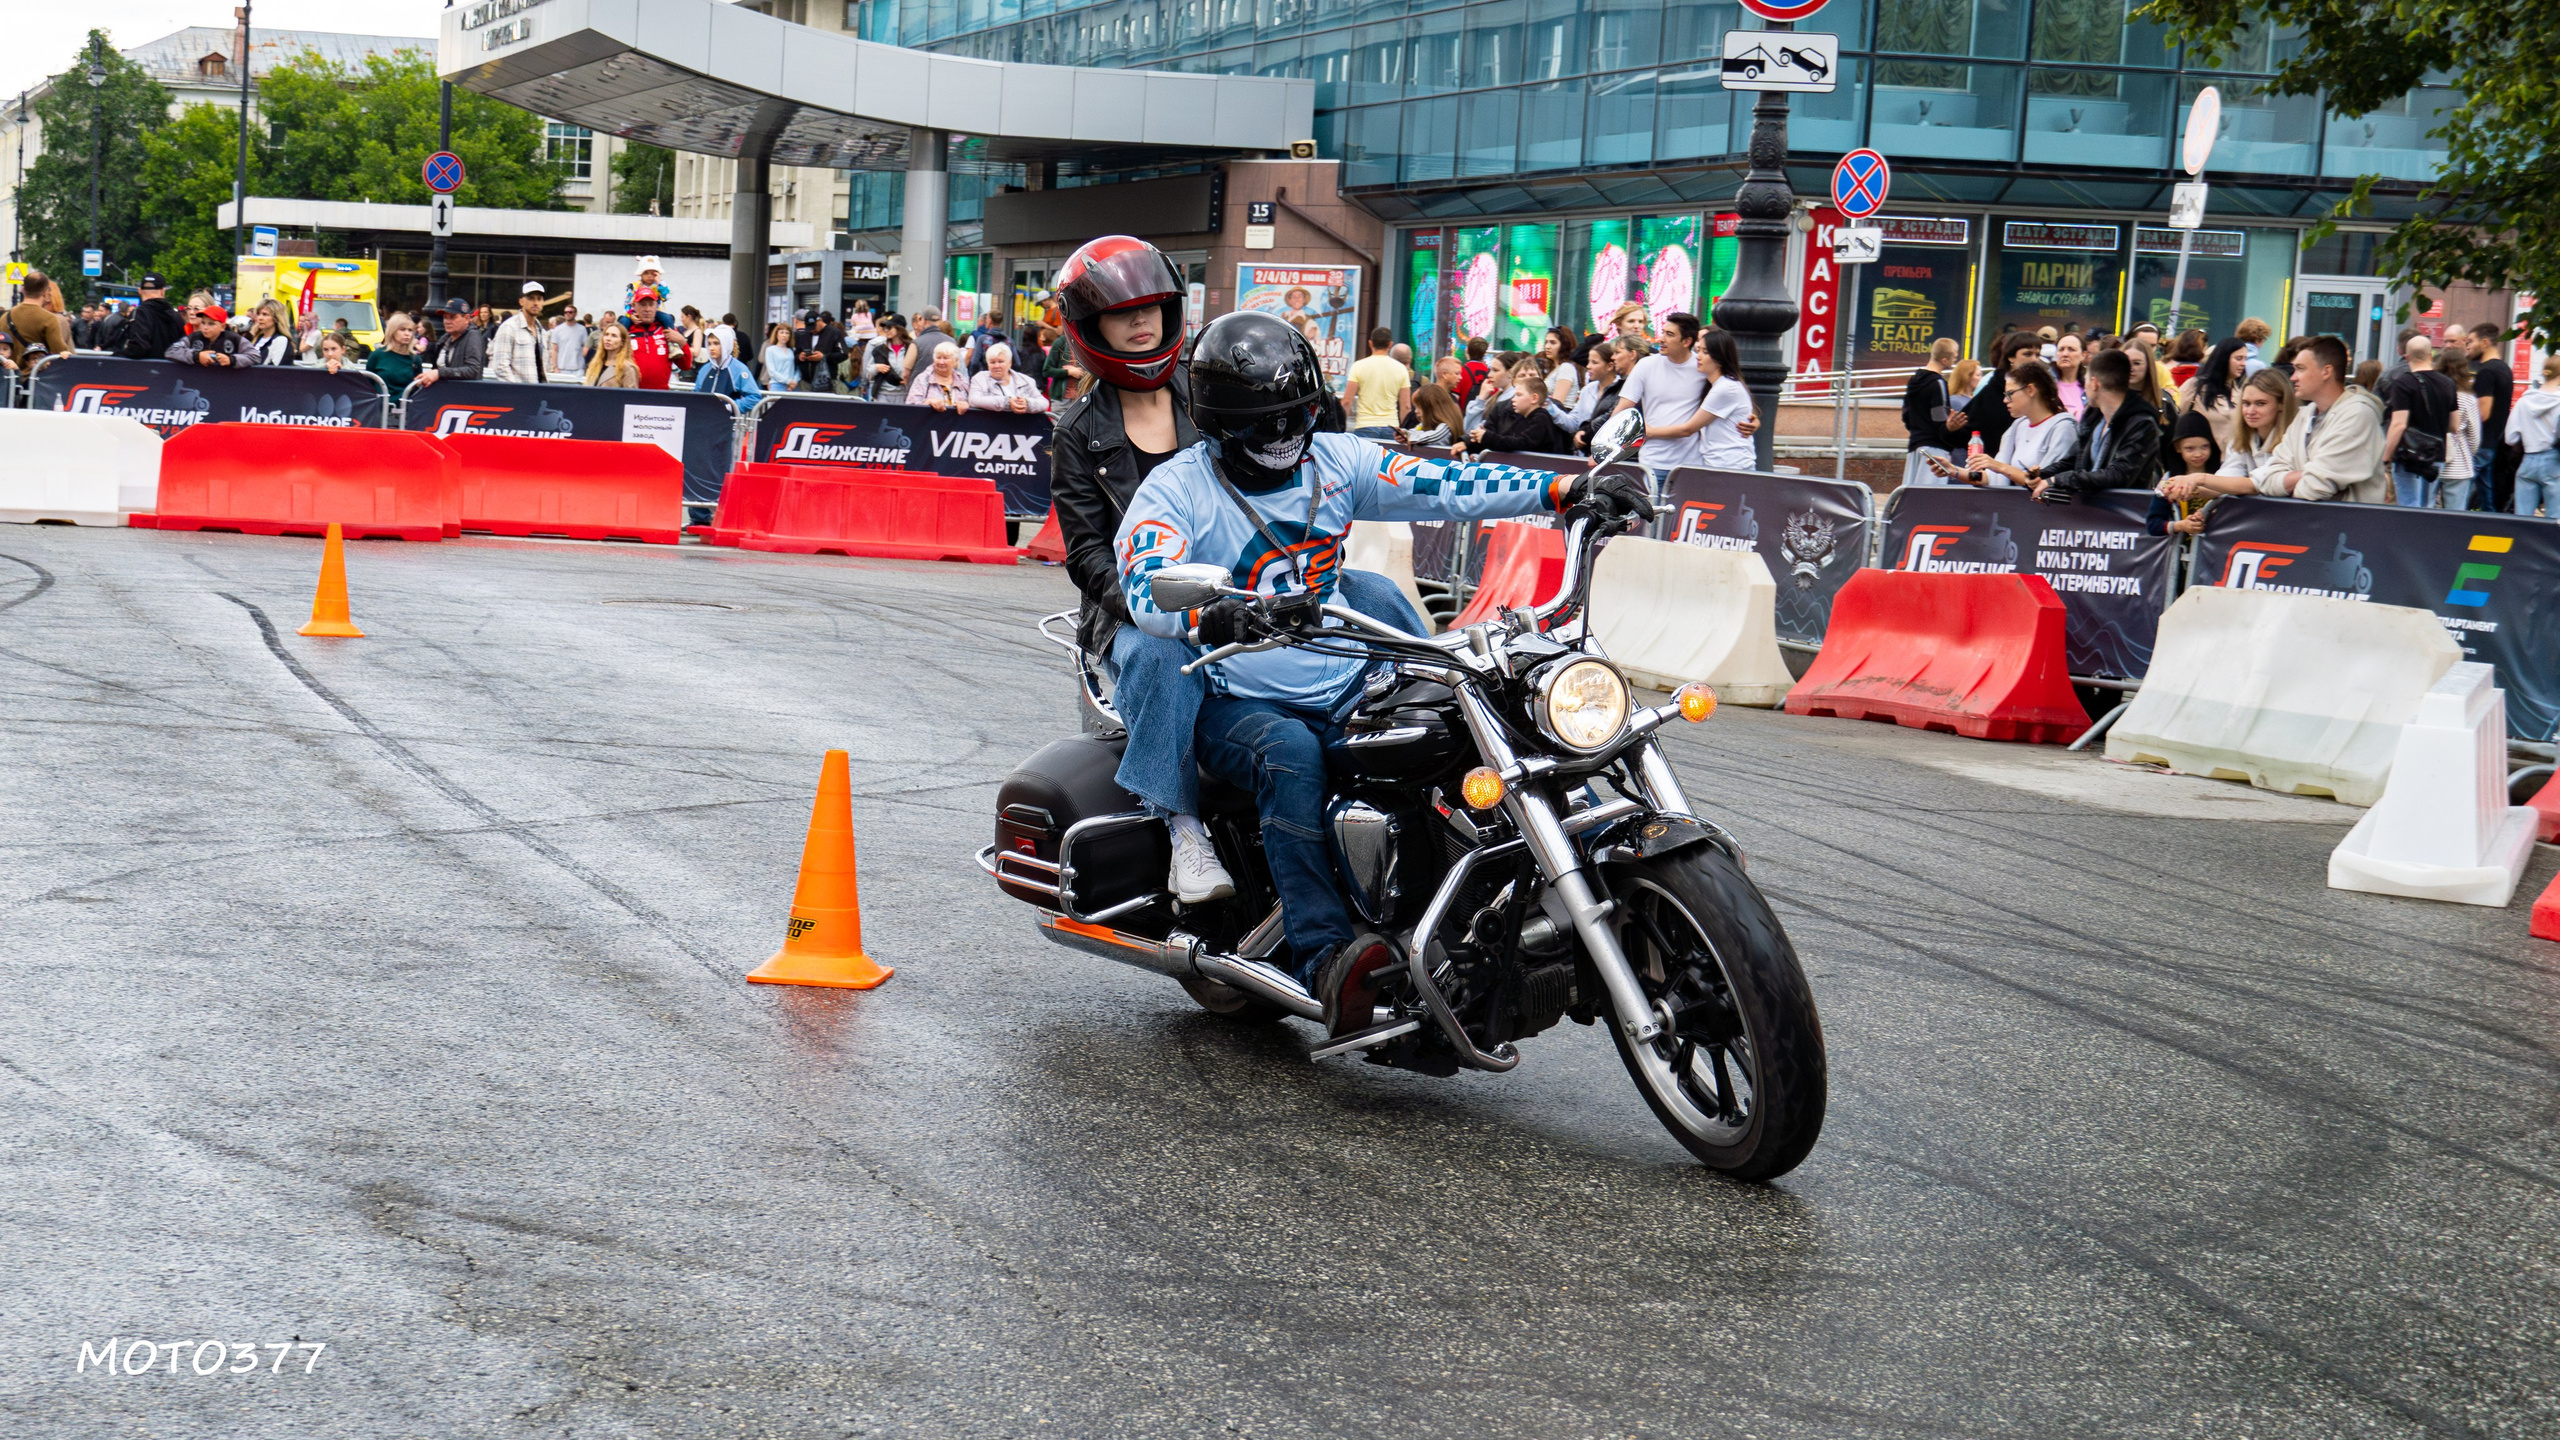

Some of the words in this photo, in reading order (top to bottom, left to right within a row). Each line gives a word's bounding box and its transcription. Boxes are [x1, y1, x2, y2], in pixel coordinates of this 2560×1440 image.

[1252, 204, 1270, 217] 15
[1901, 221, 1964, 235] ЭСТРАДЫ
[2008, 226, 2049, 239] ТЕАТР
[853, 266, 889, 280] ТАБА
[1255, 270, 1300, 284] 2/4/8/9
[2022, 262, 2094, 288] ПАРНИ
[1803, 224, 1835, 380] КАССА
[2310, 294, 2354, 309] КАССА
[1871, 323, 1934, 341] ТЕАТР
[775, 427, 911, 464] ДВИЖЕНИЕ
[930, 430, 1044, 462] VIRAX
[974, 462, 1037, 476] CAPITAL
[1230, 493, 1254, 518] YAMAHA
[1262, 526, 1284, 550] YAMAHA
[2038, 529, 2140, 550] ДЕПАРТАМЕНТ
[2036, 551, 2110, 572] КУЛЬТУРЫ
